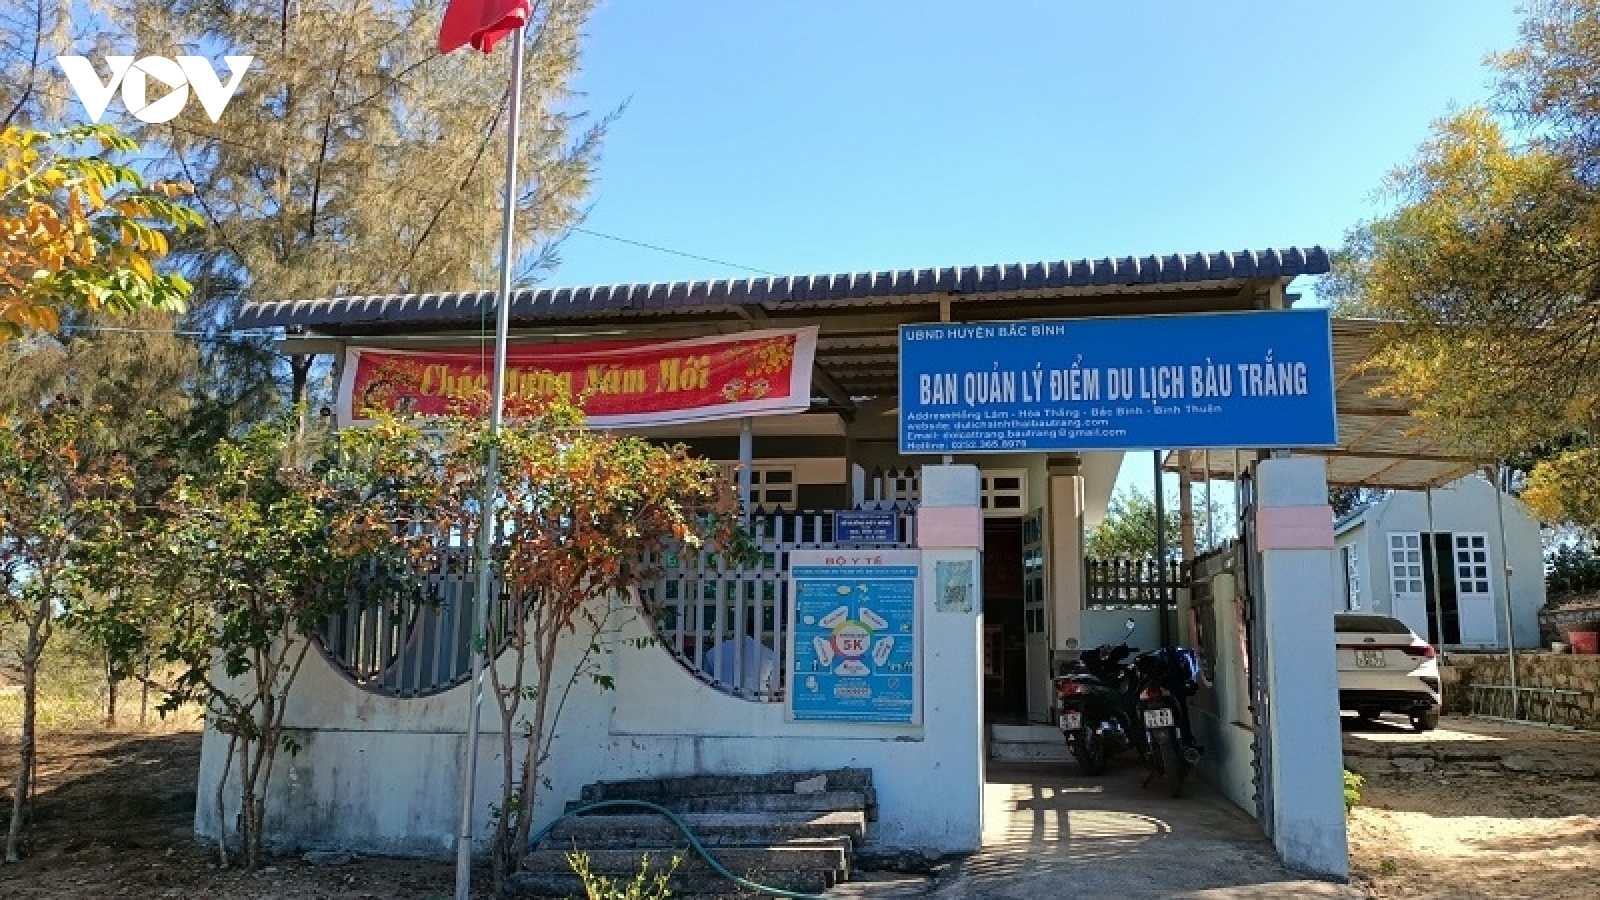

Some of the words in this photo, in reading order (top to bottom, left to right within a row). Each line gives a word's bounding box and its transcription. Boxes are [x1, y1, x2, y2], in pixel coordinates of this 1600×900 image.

[905, 328, 945, 341] UBND
[655, 354, 711, 393] Mới
[919, 373, 958, 405] BAN
[964, 361, 1016, 407] QUẢN
[1021, 361, 1043, 403] LÝ
[1049, 353, 1100, 401] ĐIỂM
[1107, 367, 1133, 400] DU
[1139, 365, 1185, 405] LỊCH
[1190, 357, 1233, 397] BÀU
[1237, 347, 1309, 397] TRẮNG
[843, 639, 863, 651] 5K
